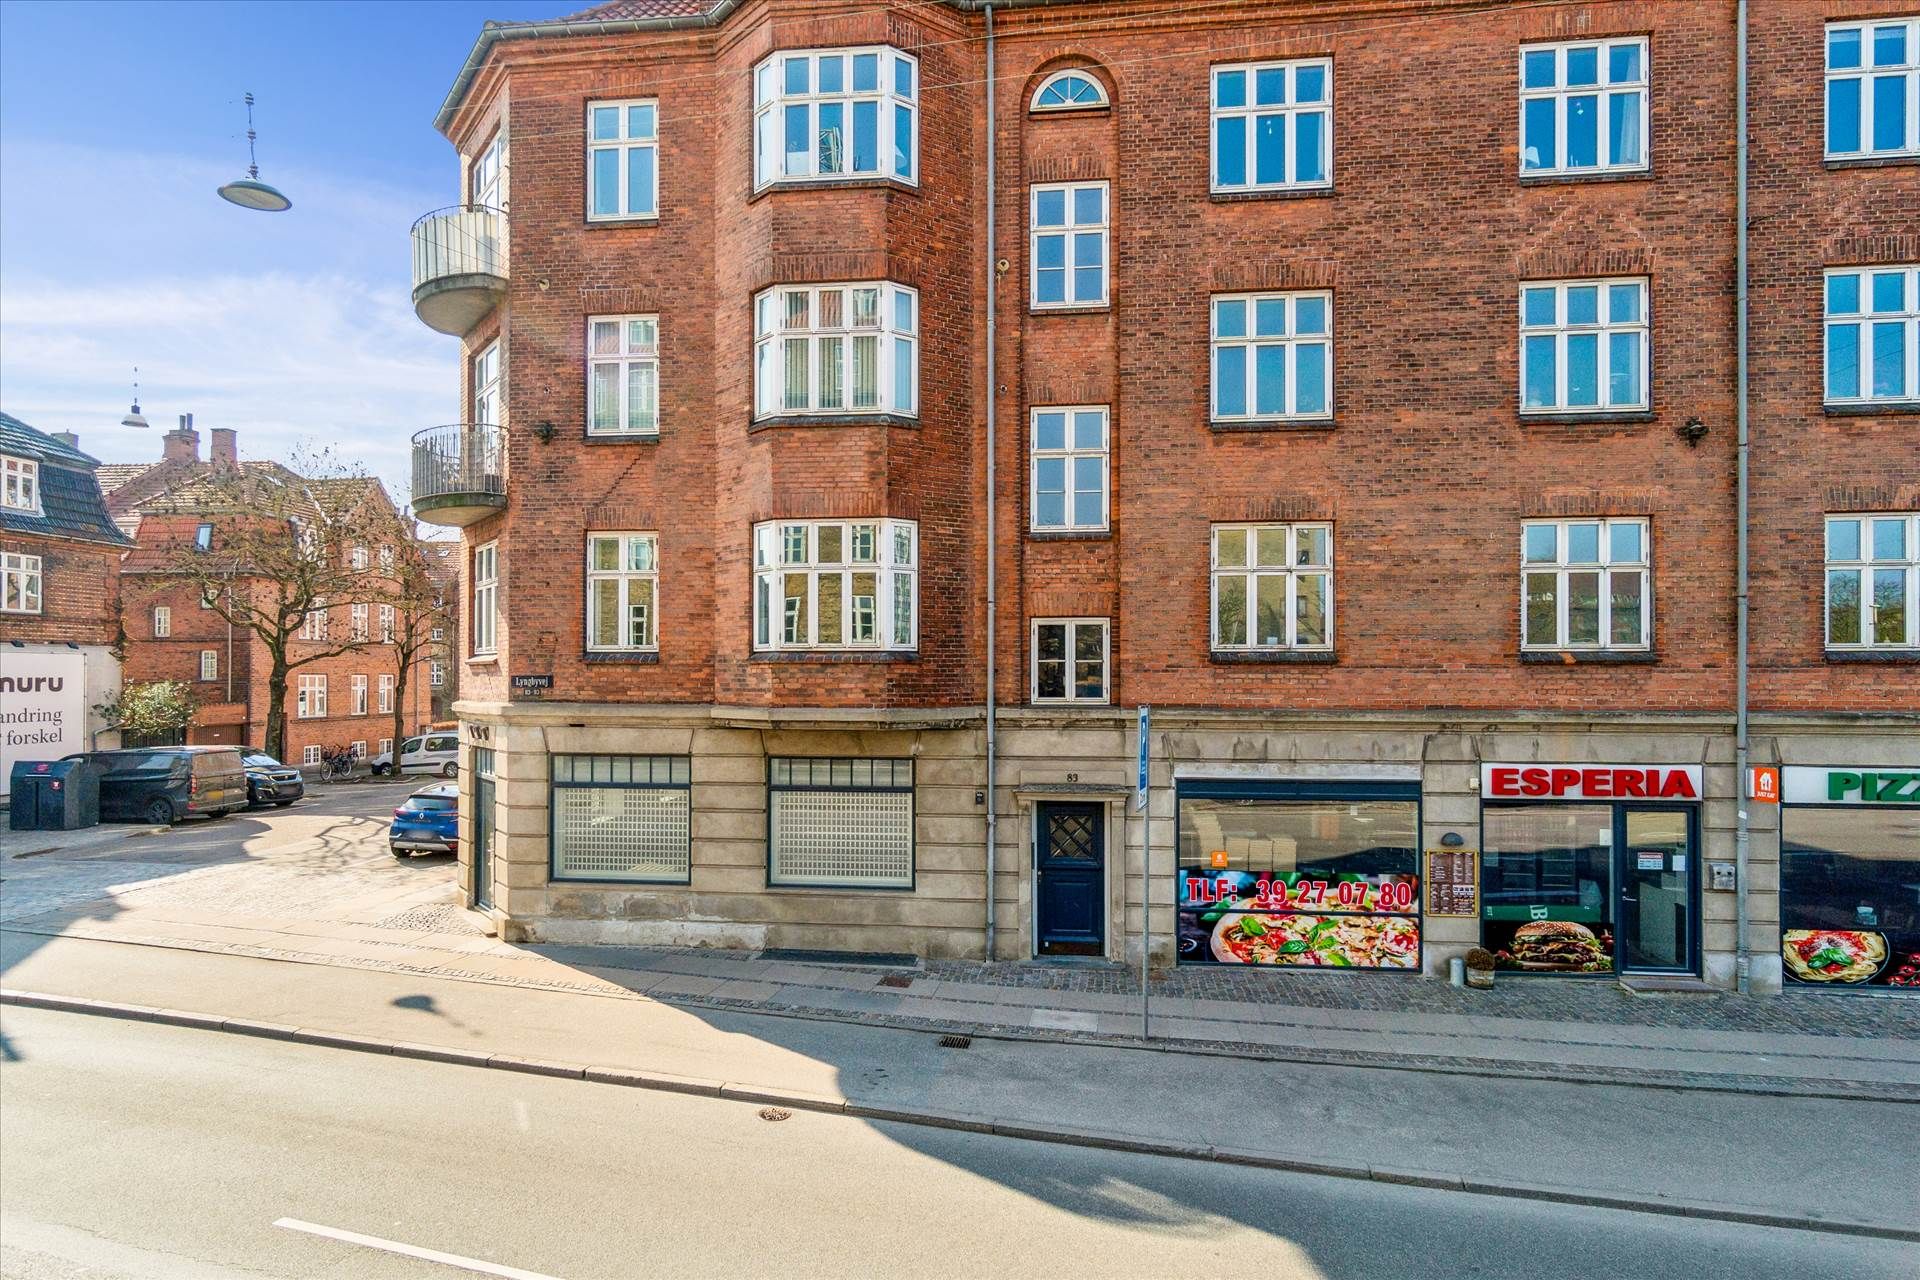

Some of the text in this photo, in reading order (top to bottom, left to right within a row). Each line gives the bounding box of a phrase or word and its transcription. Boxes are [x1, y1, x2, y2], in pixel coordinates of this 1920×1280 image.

[515, 676, 549, 688] Lyngbyvej
[7, 727, 63, 746] forskel
[1066, 773, 1079, 783] 83
[1491, 768, 1697, 798] ESPERIA
[1186, 878, 1238, 902] TLF:
[1255, 880, 1288, 904] 39
[1296, 881, 1328, 905] 27
[1337, 882, 1370, 905] 07
[1379, 882, 1413, 906] 80
